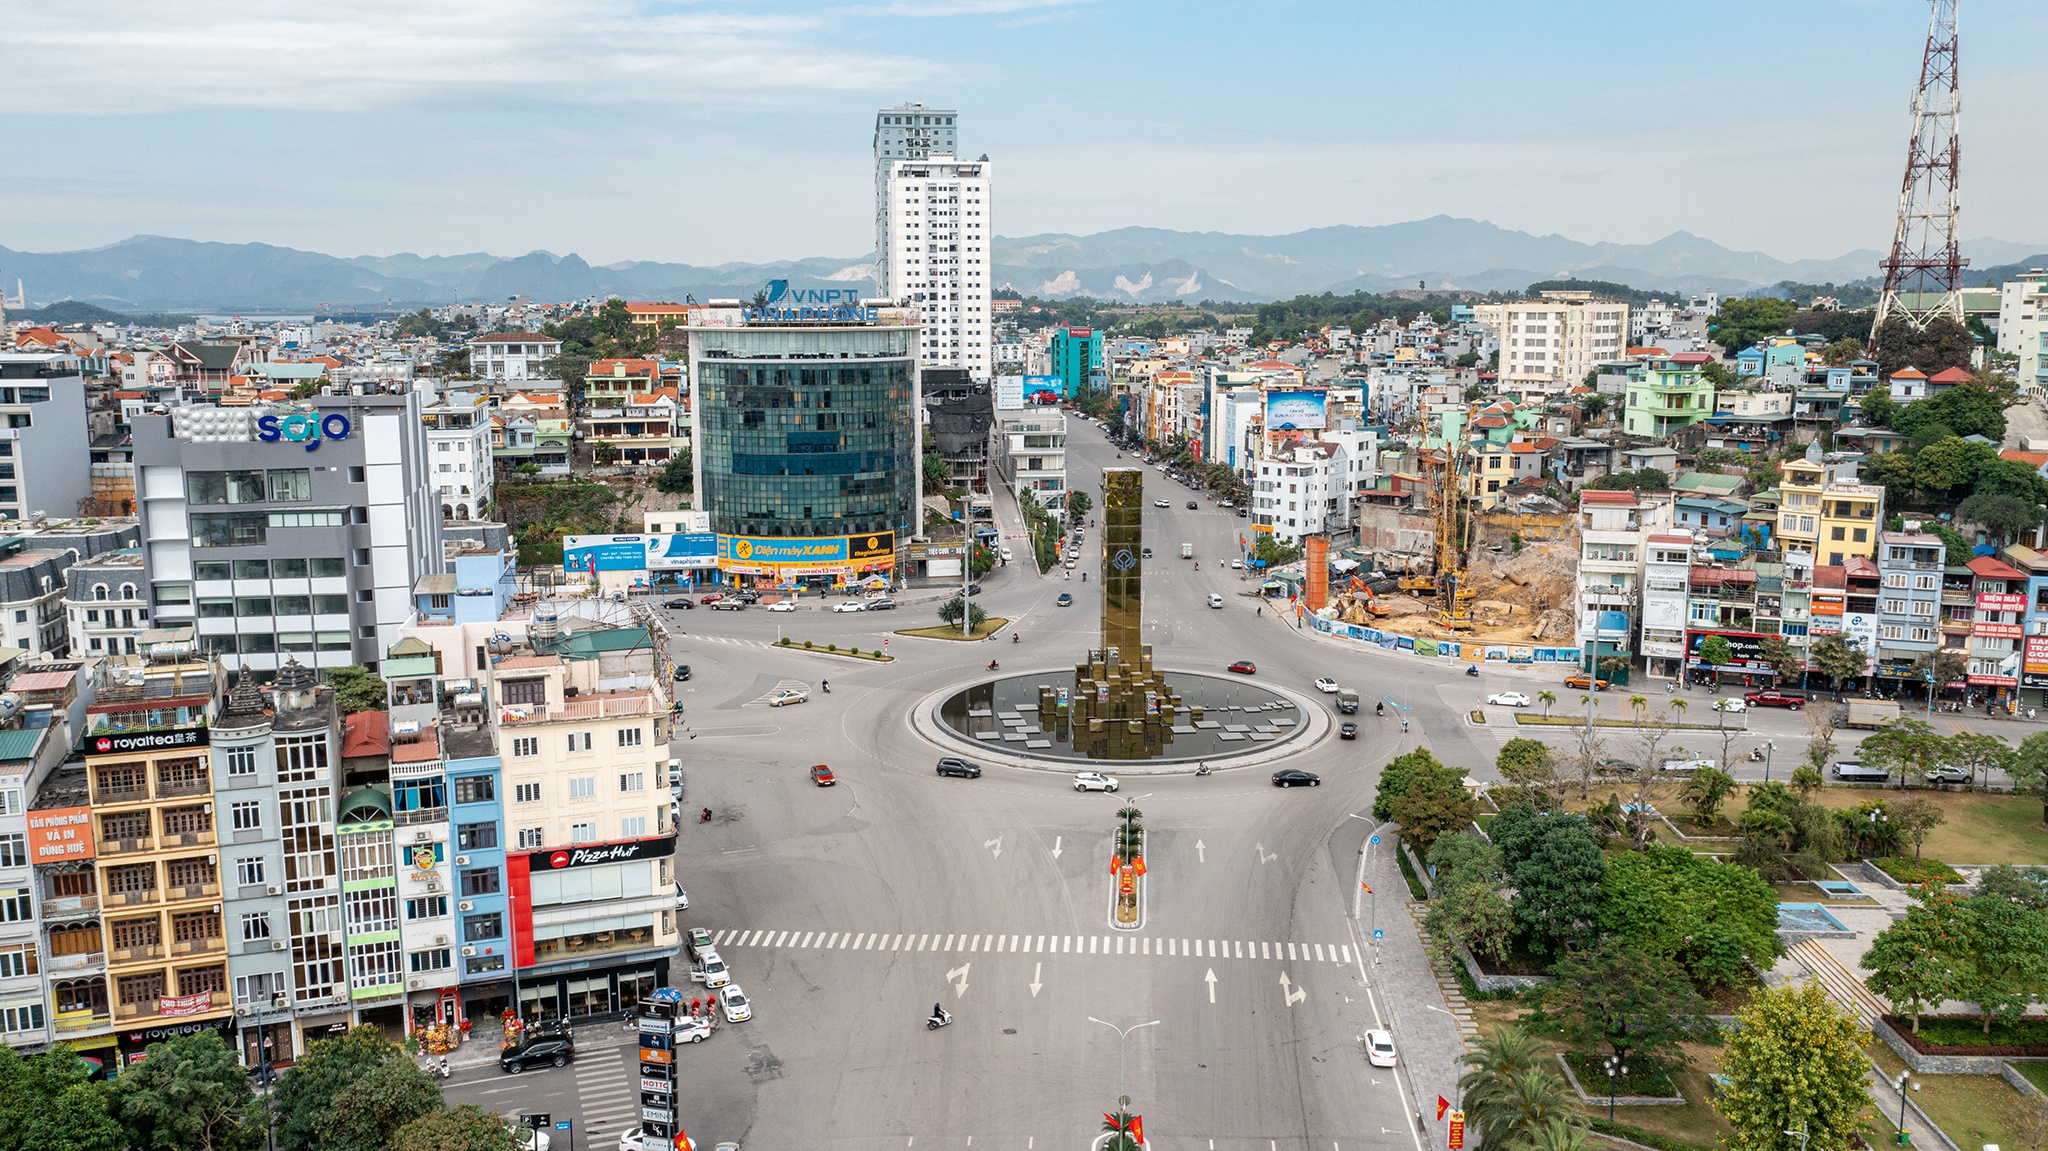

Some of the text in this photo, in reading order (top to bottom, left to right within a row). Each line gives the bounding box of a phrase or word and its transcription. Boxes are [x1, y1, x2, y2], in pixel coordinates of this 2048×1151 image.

[792, 289, 858, 303] VNPT
[742, 307, 879, 322] VINAPHONE
[258, 412, 350, 452] sojo
[754, 544, 840, 557] Điện máy XANH
[1979, 602, 2001, 610] TRUNG
[113, 733, 175, 750] royaltea
[30, 817, 45, 829] VĂN
[45, 814, 68, 827] PHÒNG
[46, 829, 75, 841] VÀ IN
[66, 840, 85, 854] HUỆ
[570, 844, 640, 866] Pizza Hut
[161, 999, 175, 1008] CHO
